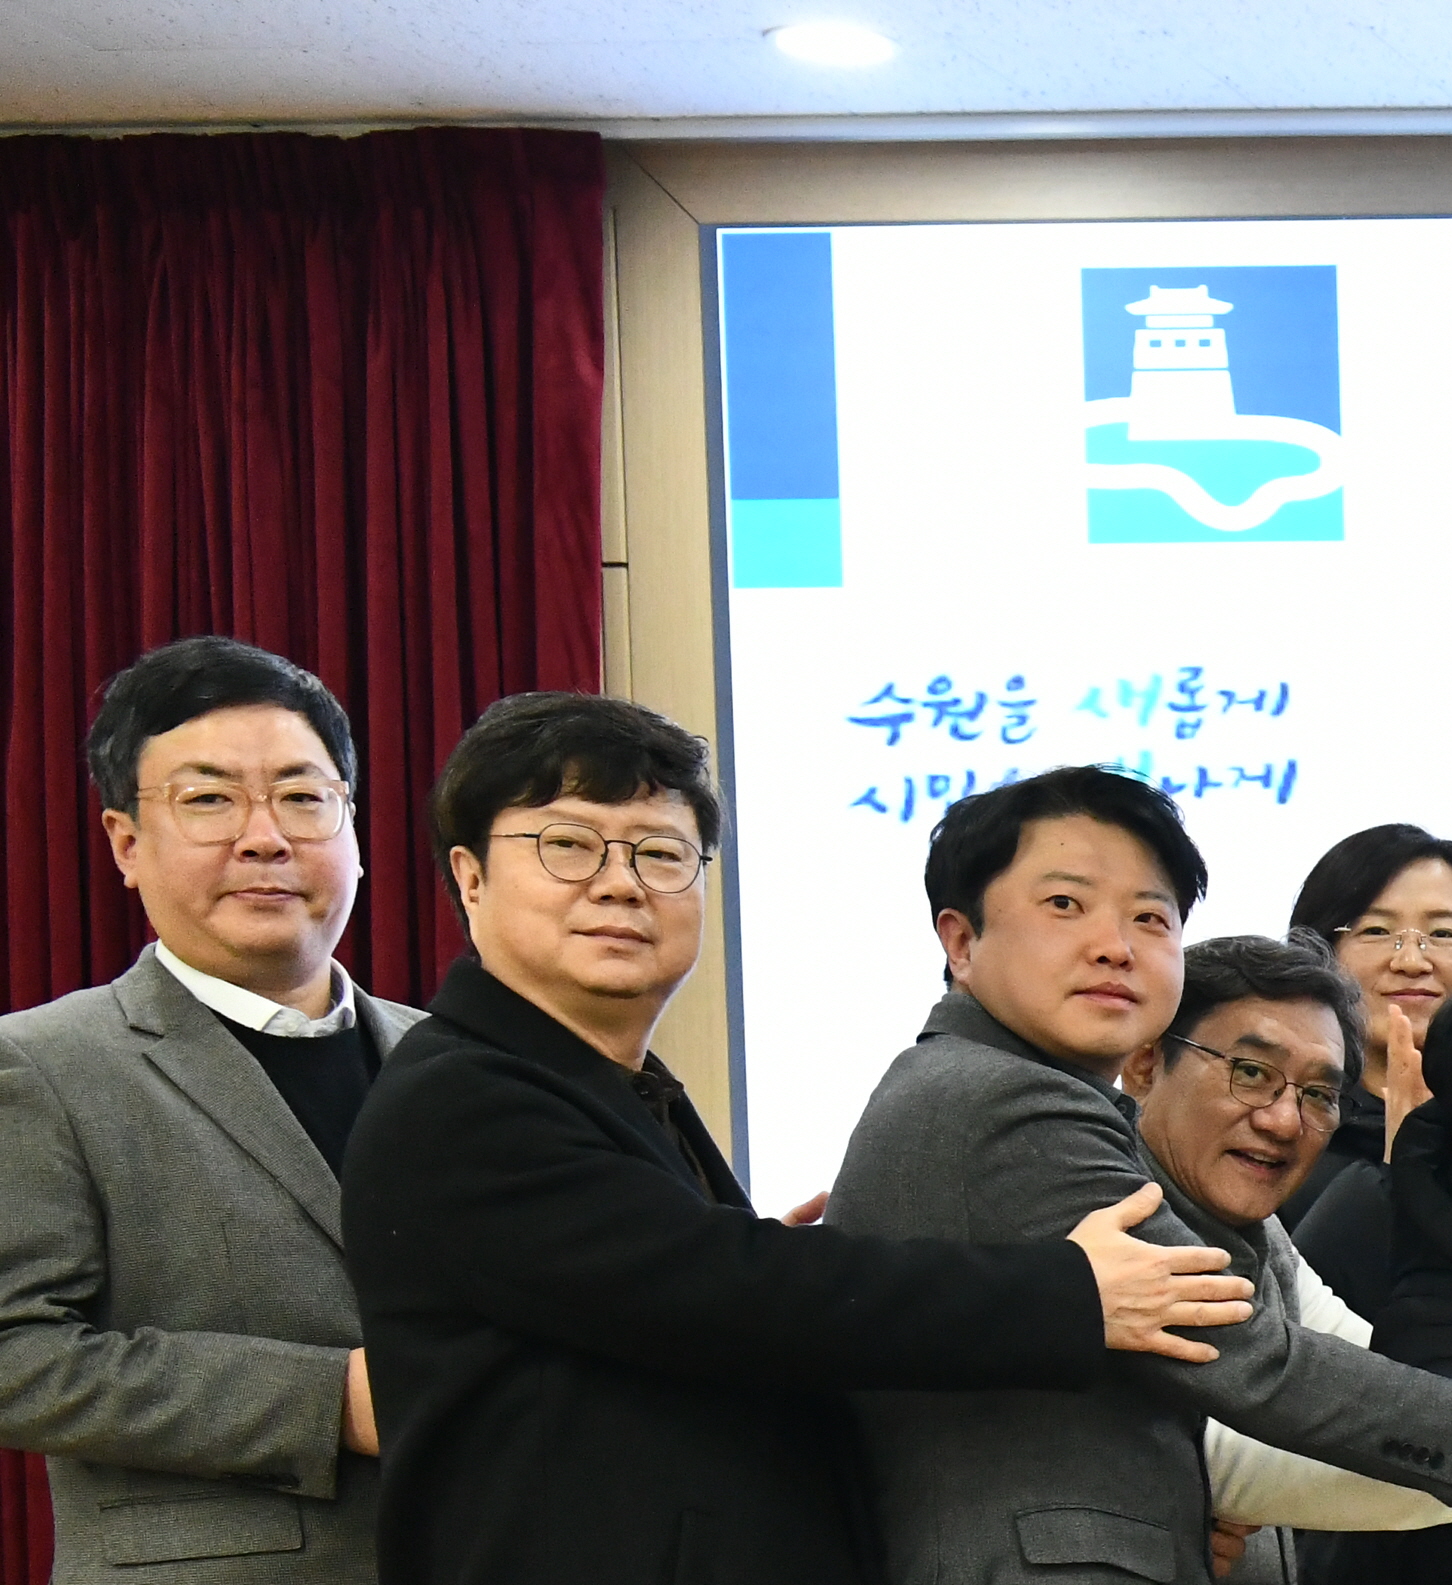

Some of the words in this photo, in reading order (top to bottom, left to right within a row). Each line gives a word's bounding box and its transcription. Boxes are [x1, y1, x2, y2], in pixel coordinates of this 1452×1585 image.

[845, 674, 1037, 747] 수원을
[1076, 666, 1290, 740] 새롭게
[851, 767, 1022, 822] 시민
[1115, 751, 1297, 804] 나게
